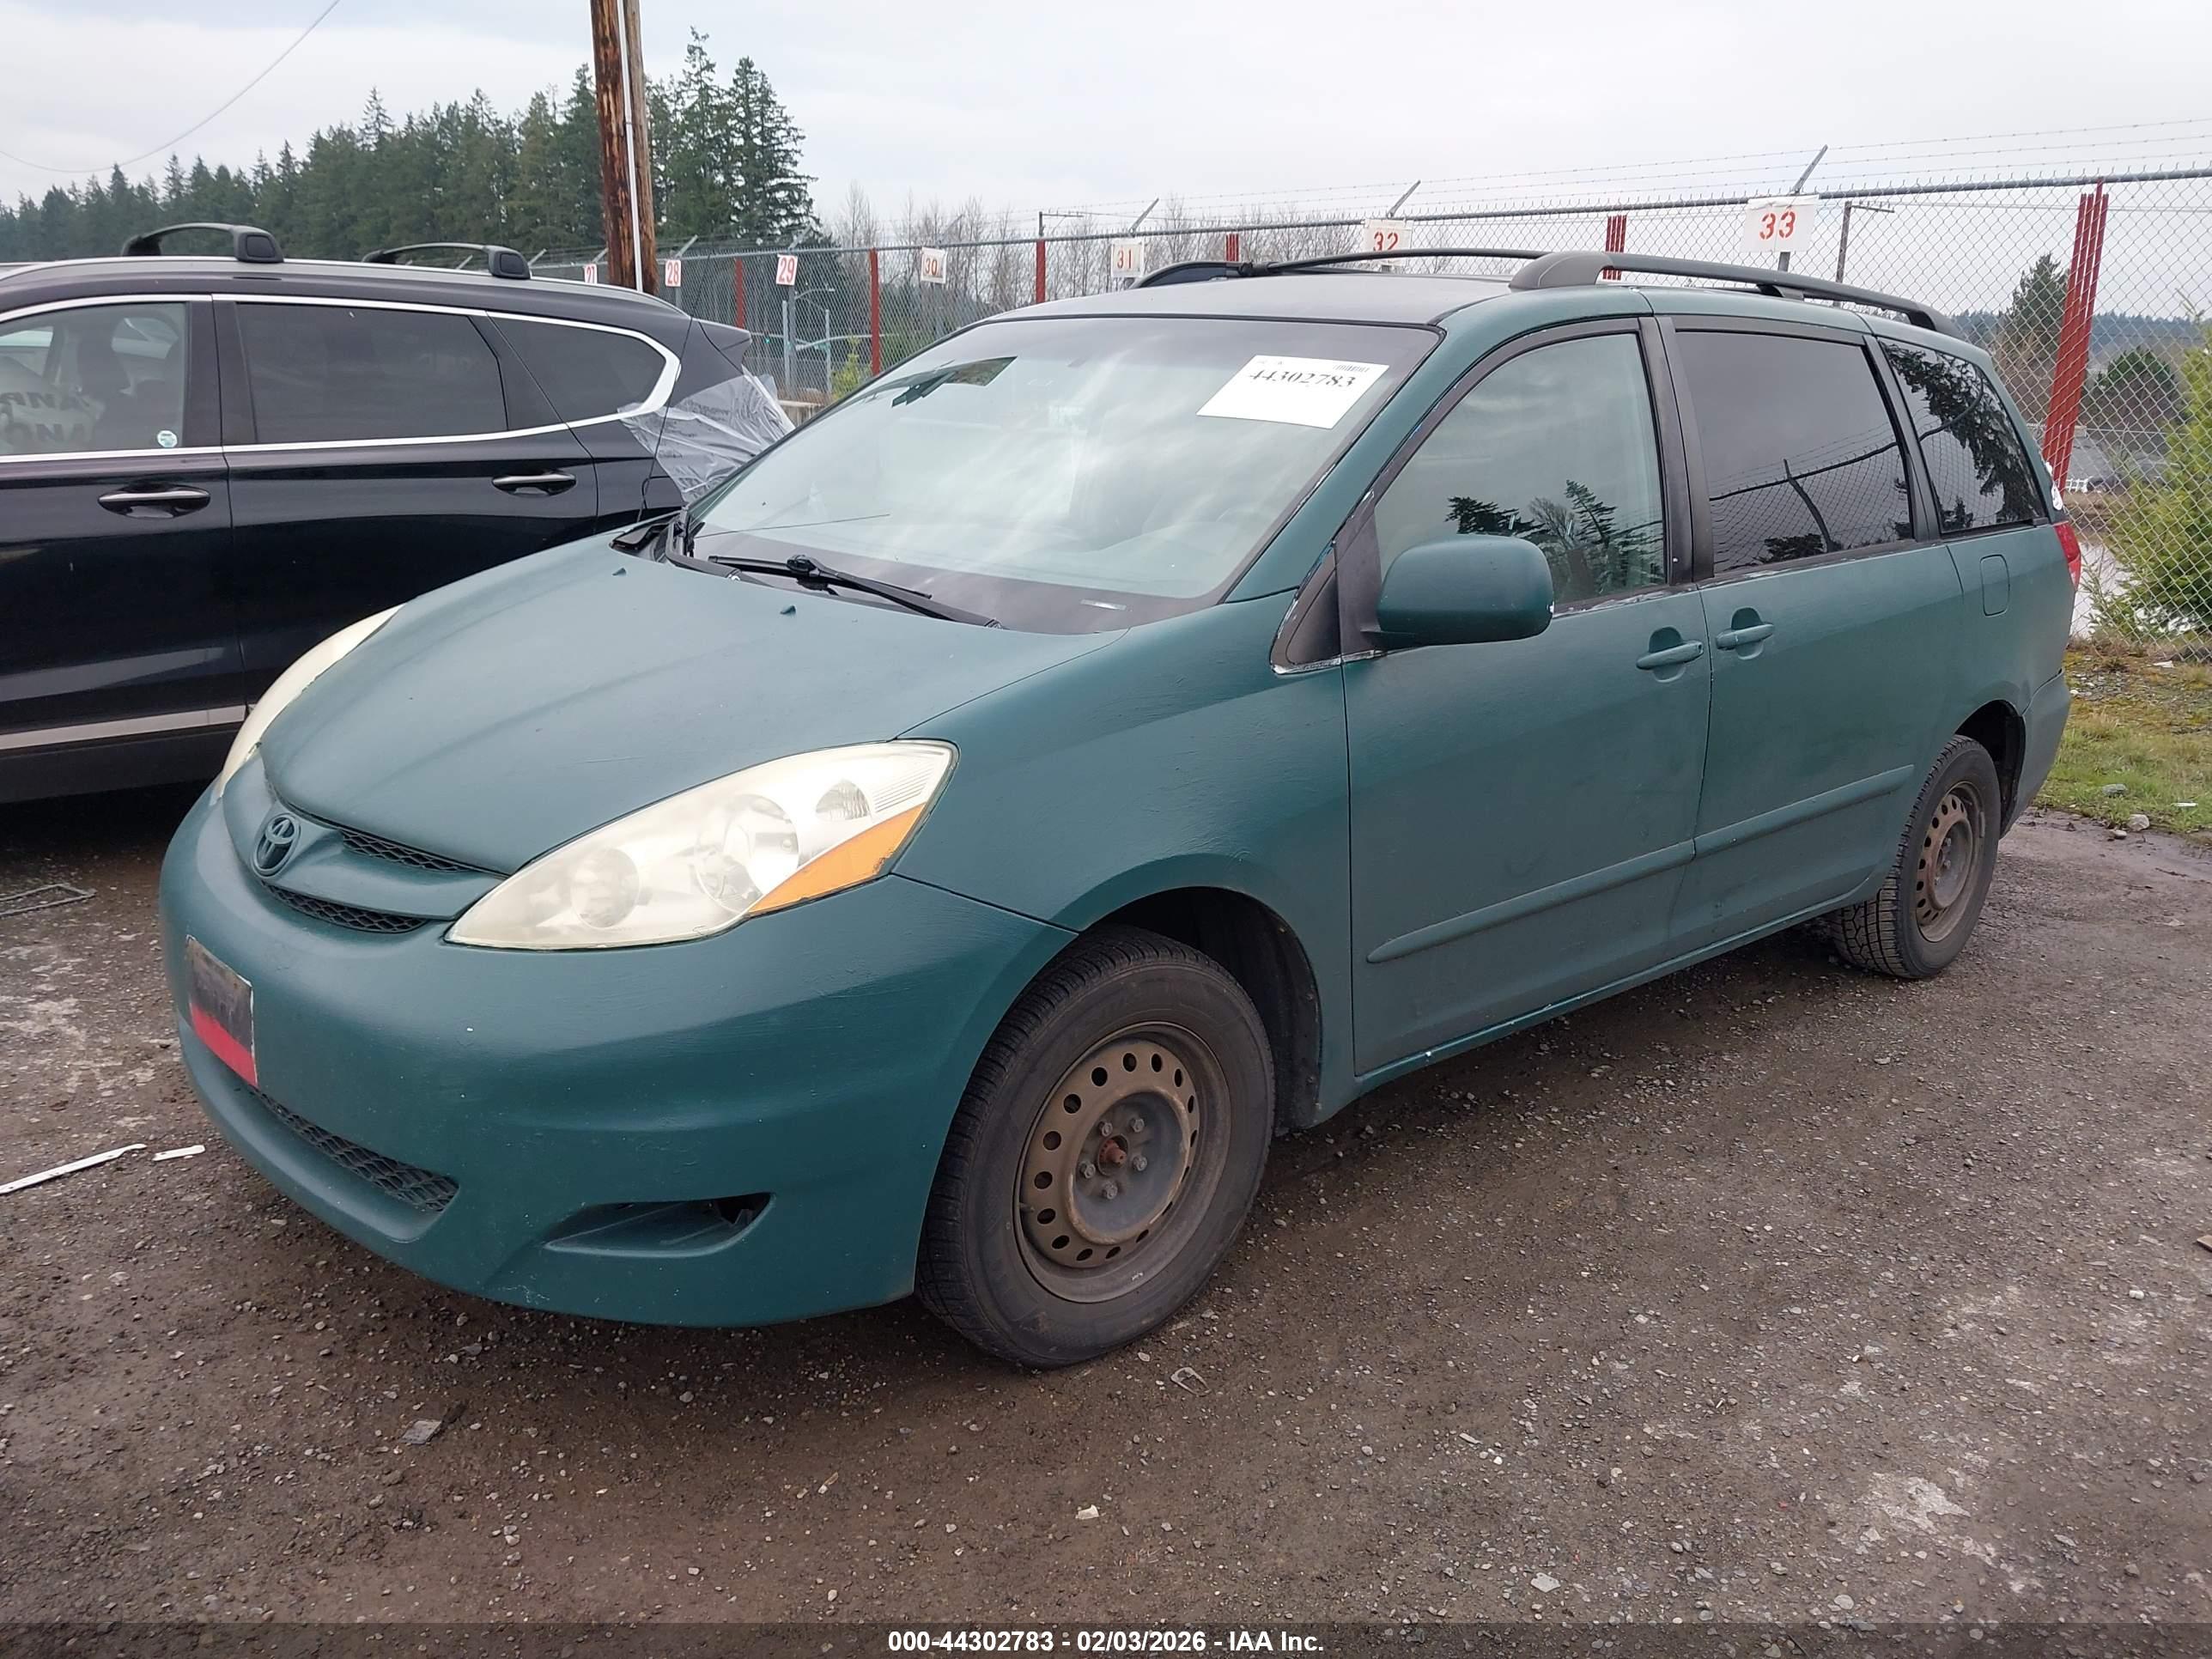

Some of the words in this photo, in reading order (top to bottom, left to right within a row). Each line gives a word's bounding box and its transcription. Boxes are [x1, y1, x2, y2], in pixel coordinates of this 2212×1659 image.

[1759, 211, 1796, 240] 33
[1374, 232, 1398, 251] 32
[925, 258, 938, 276] 30
[1117, 249, 1132, 269] 31
[667, 262, 679, 284] 28
[779, 257, 795, 283] 29
[1249, 369, 1357, 387] 44302783
